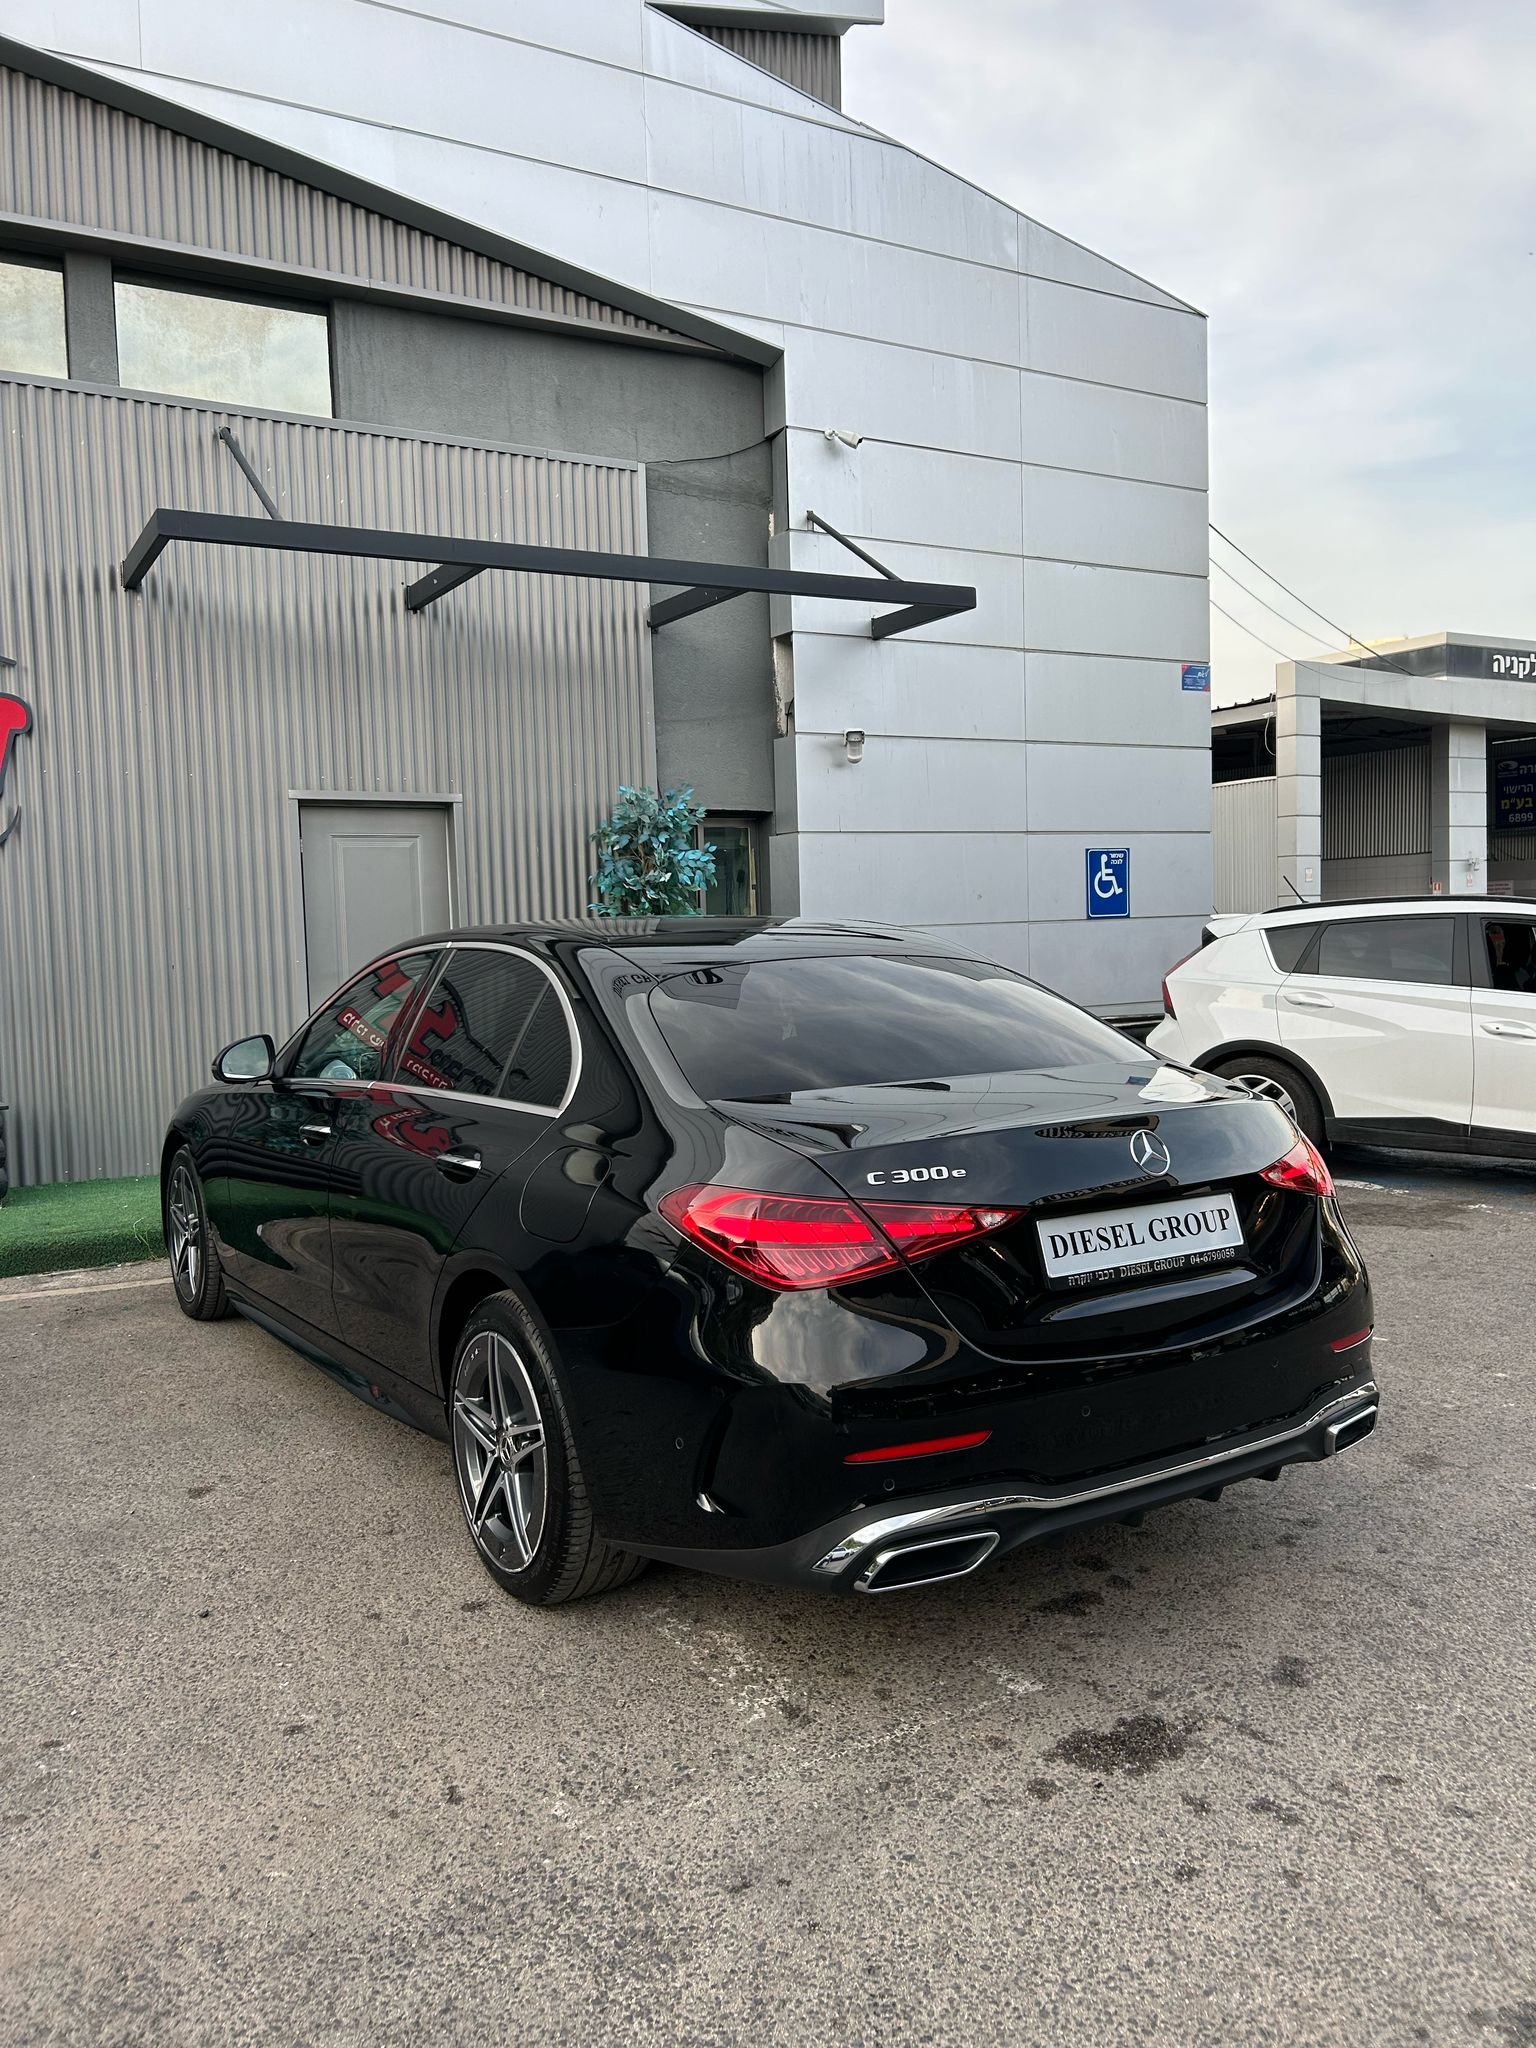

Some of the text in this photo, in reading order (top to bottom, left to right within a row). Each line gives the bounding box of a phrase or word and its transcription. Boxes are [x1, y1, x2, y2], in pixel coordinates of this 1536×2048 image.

[1048, 1208, 1230, 1260] DIESEL GROUP
[1120, 1262, 1153, 1278] DIESEL
[1153, 1256, 1186, 1272] GROUP
[1190, 1247, 1236, 1265] 04-6790058
